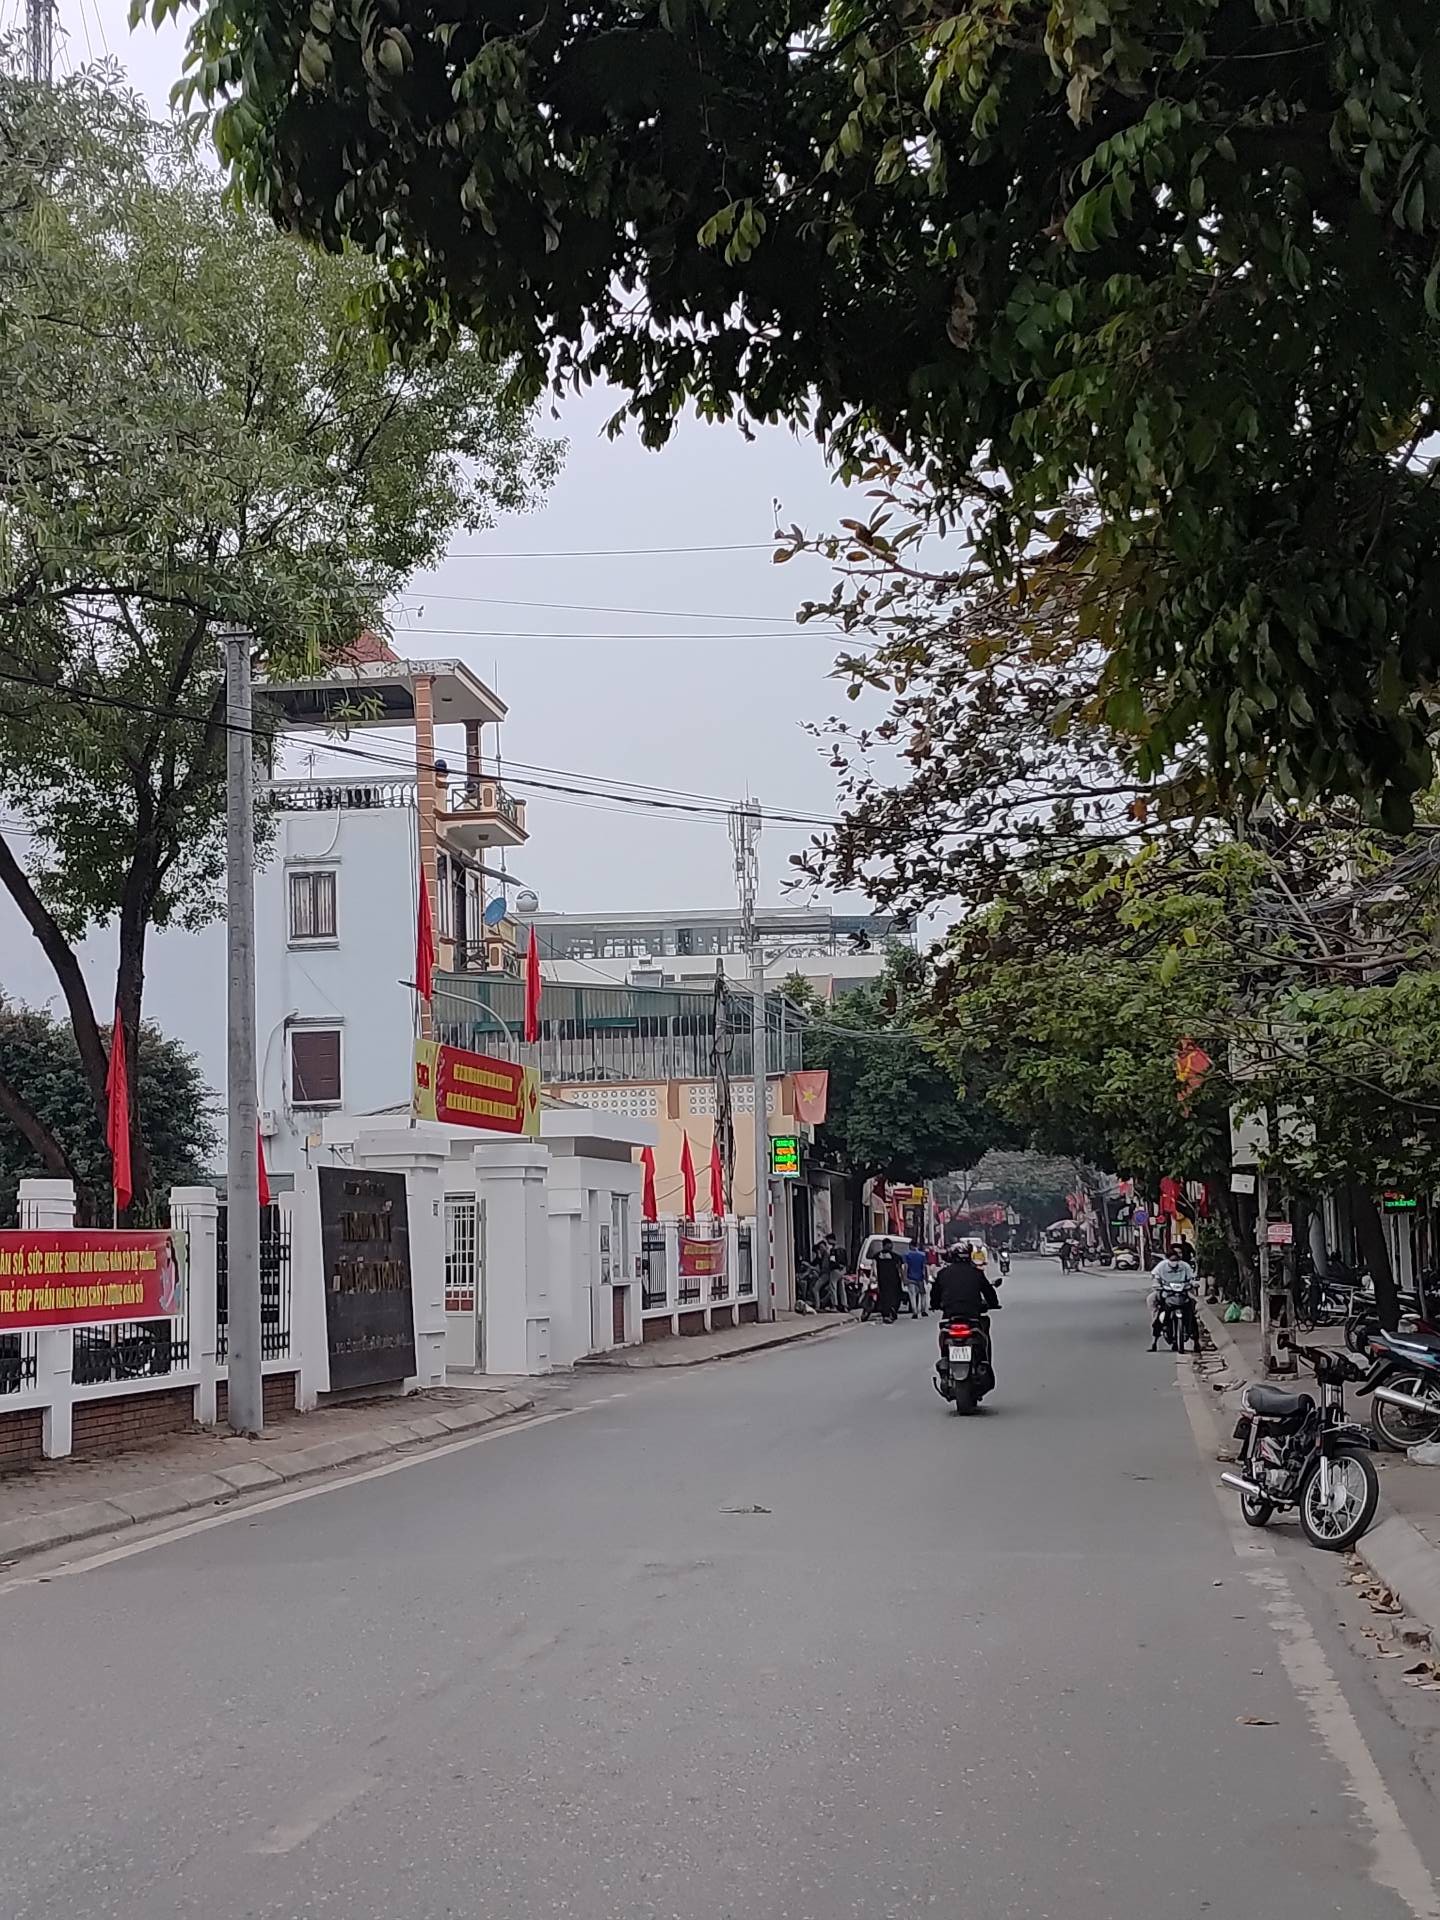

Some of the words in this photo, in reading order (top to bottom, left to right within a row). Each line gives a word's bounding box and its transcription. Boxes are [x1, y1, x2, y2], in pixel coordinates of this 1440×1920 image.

[27, 1245, 43, 1275] SỨC
[16, 1284, 33, 1313] GÓP
[75, 1286, 88, 1308] CAO
